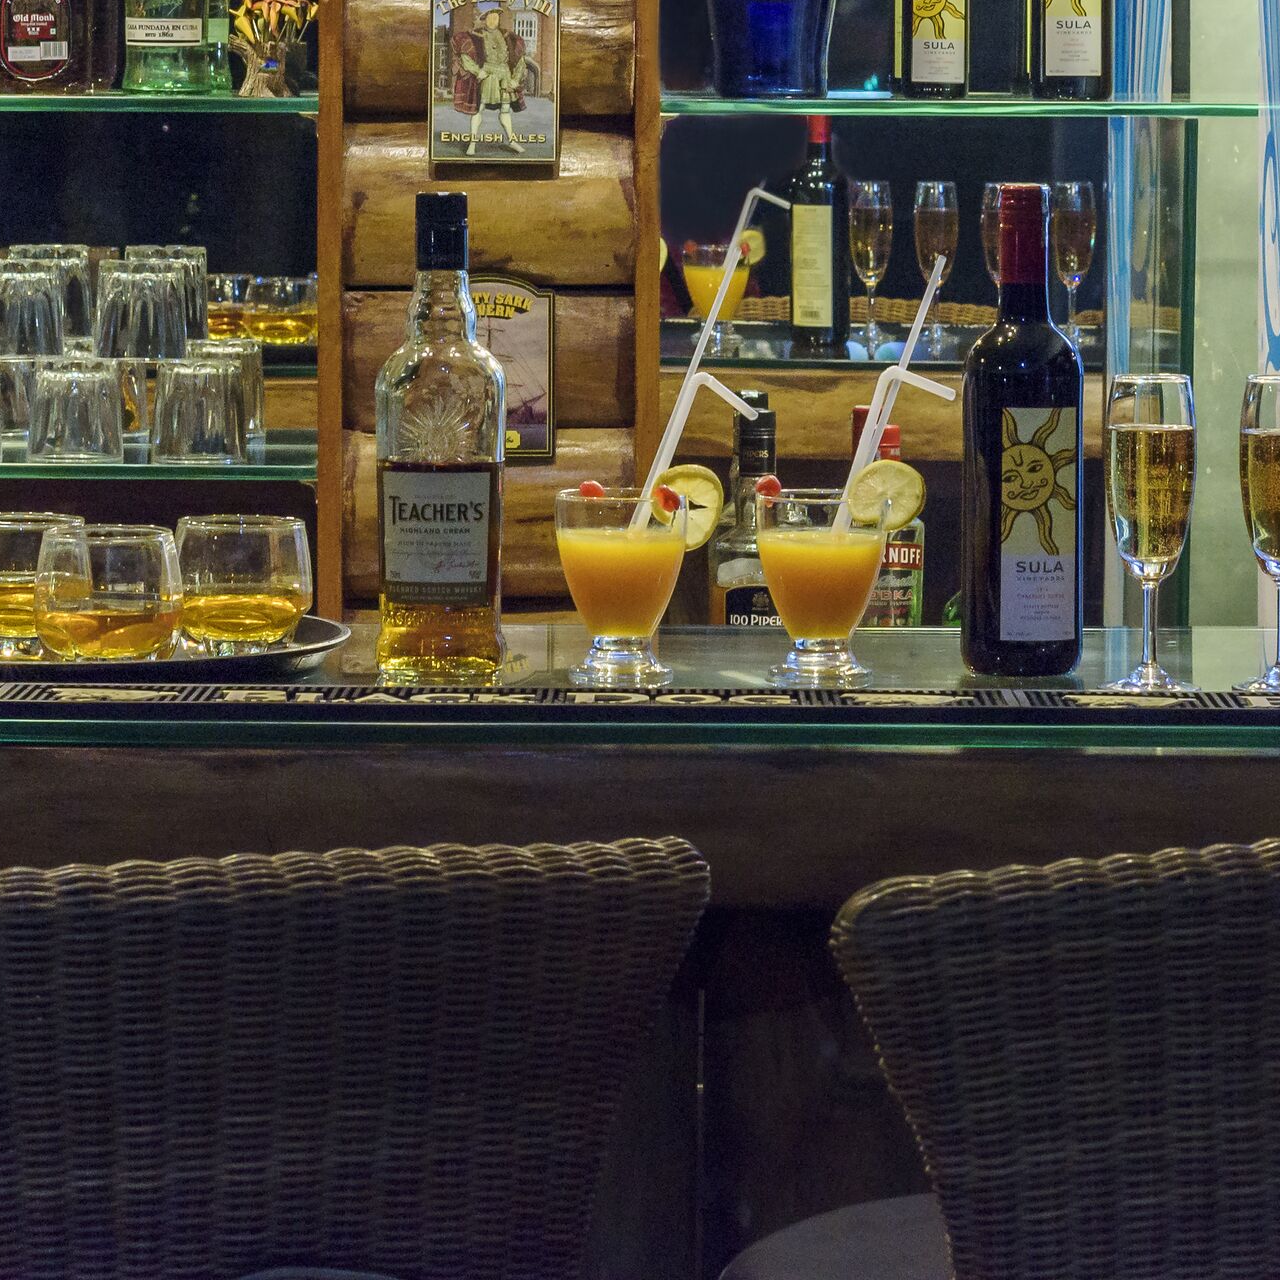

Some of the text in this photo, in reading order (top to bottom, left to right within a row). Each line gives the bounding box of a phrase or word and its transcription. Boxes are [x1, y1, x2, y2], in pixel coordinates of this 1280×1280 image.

[138, 23, 170, 32] FUNDADA
[1056, 20, 1092, 29] SULA
[923, 41, 955, 50] SULA
[440, 131, 547, 143] ENGLISH ALES
[495, 292, 533, 311] SARK
[477, 304, 515, 318] VERN
[389, 495, 484, 525] TEACHER'S
[1016, 561, 1064, 573] SULA
[730, 614, 785, 627] 100 PIPER
[214, 690, 798, 705] BLACK DOG
